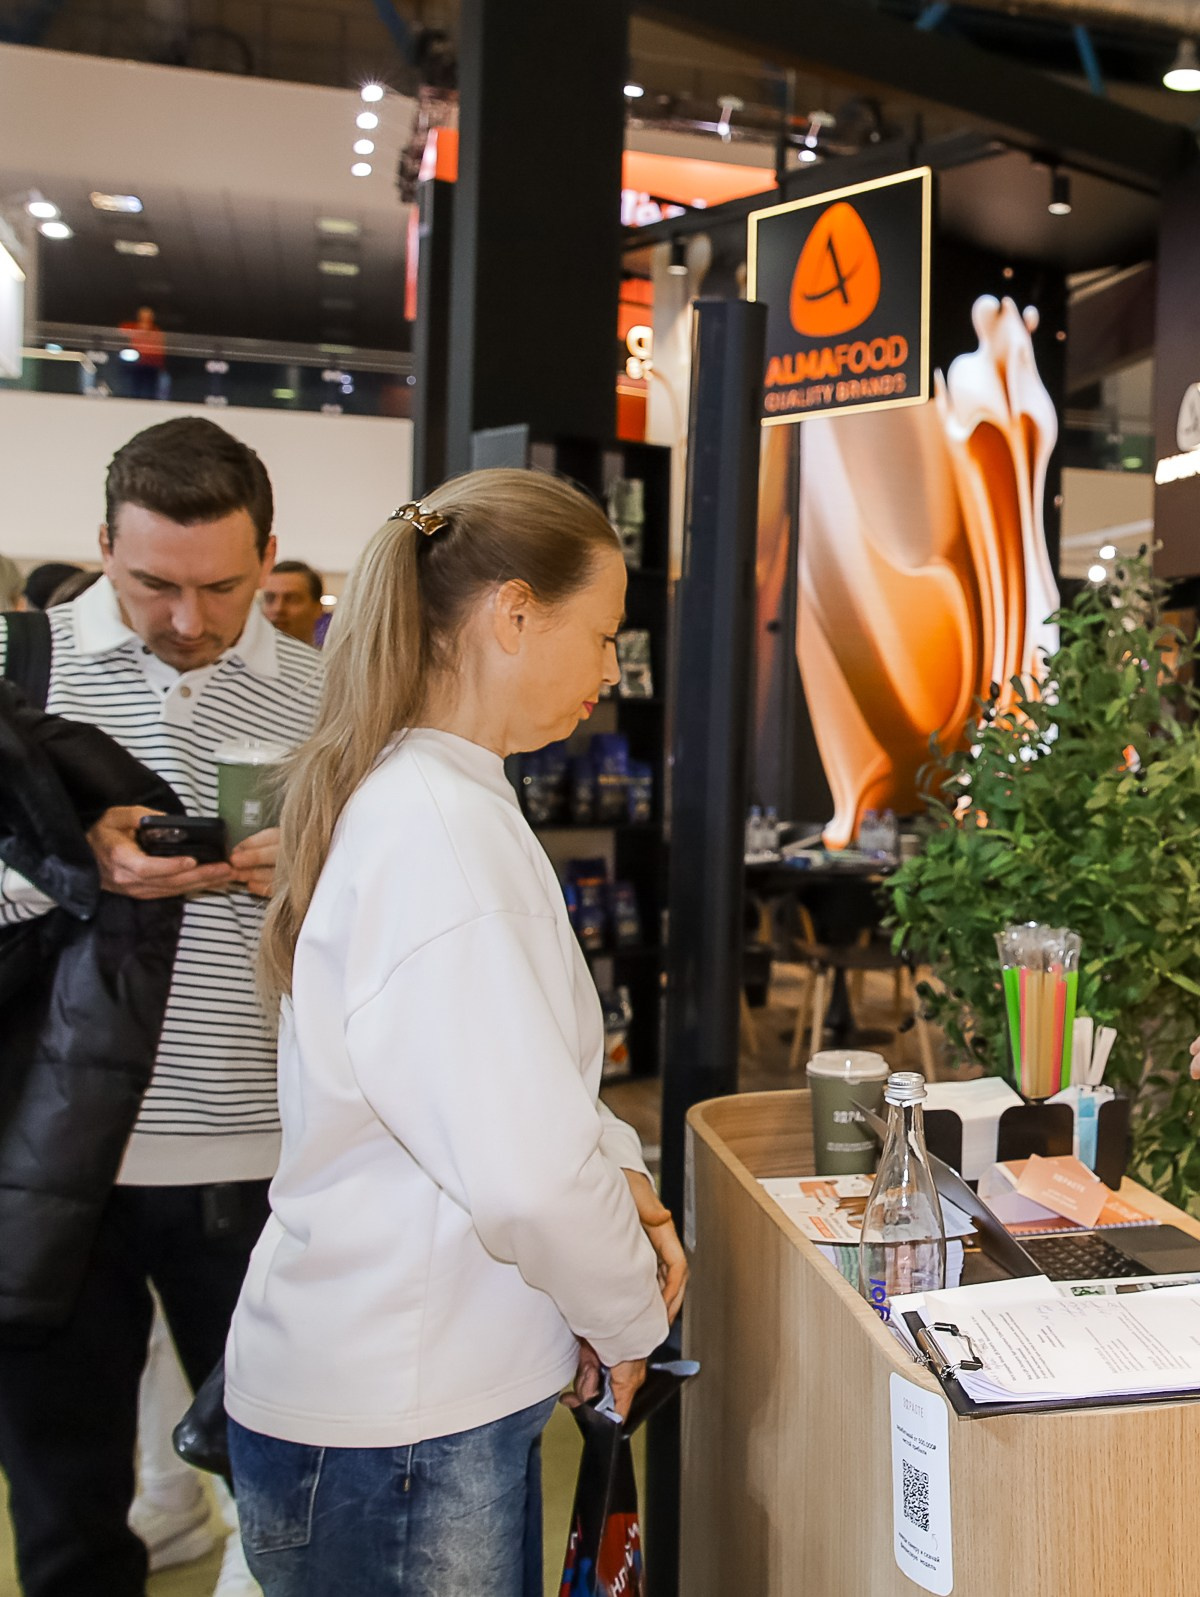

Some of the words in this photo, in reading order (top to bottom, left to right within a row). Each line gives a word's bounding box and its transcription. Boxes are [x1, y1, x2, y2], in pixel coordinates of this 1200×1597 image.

[764, 334, 909, 388] ALMAFOOD
[764, 382, 834, 412] QUALITY
[835, 372, 907, 403] BRANDS
